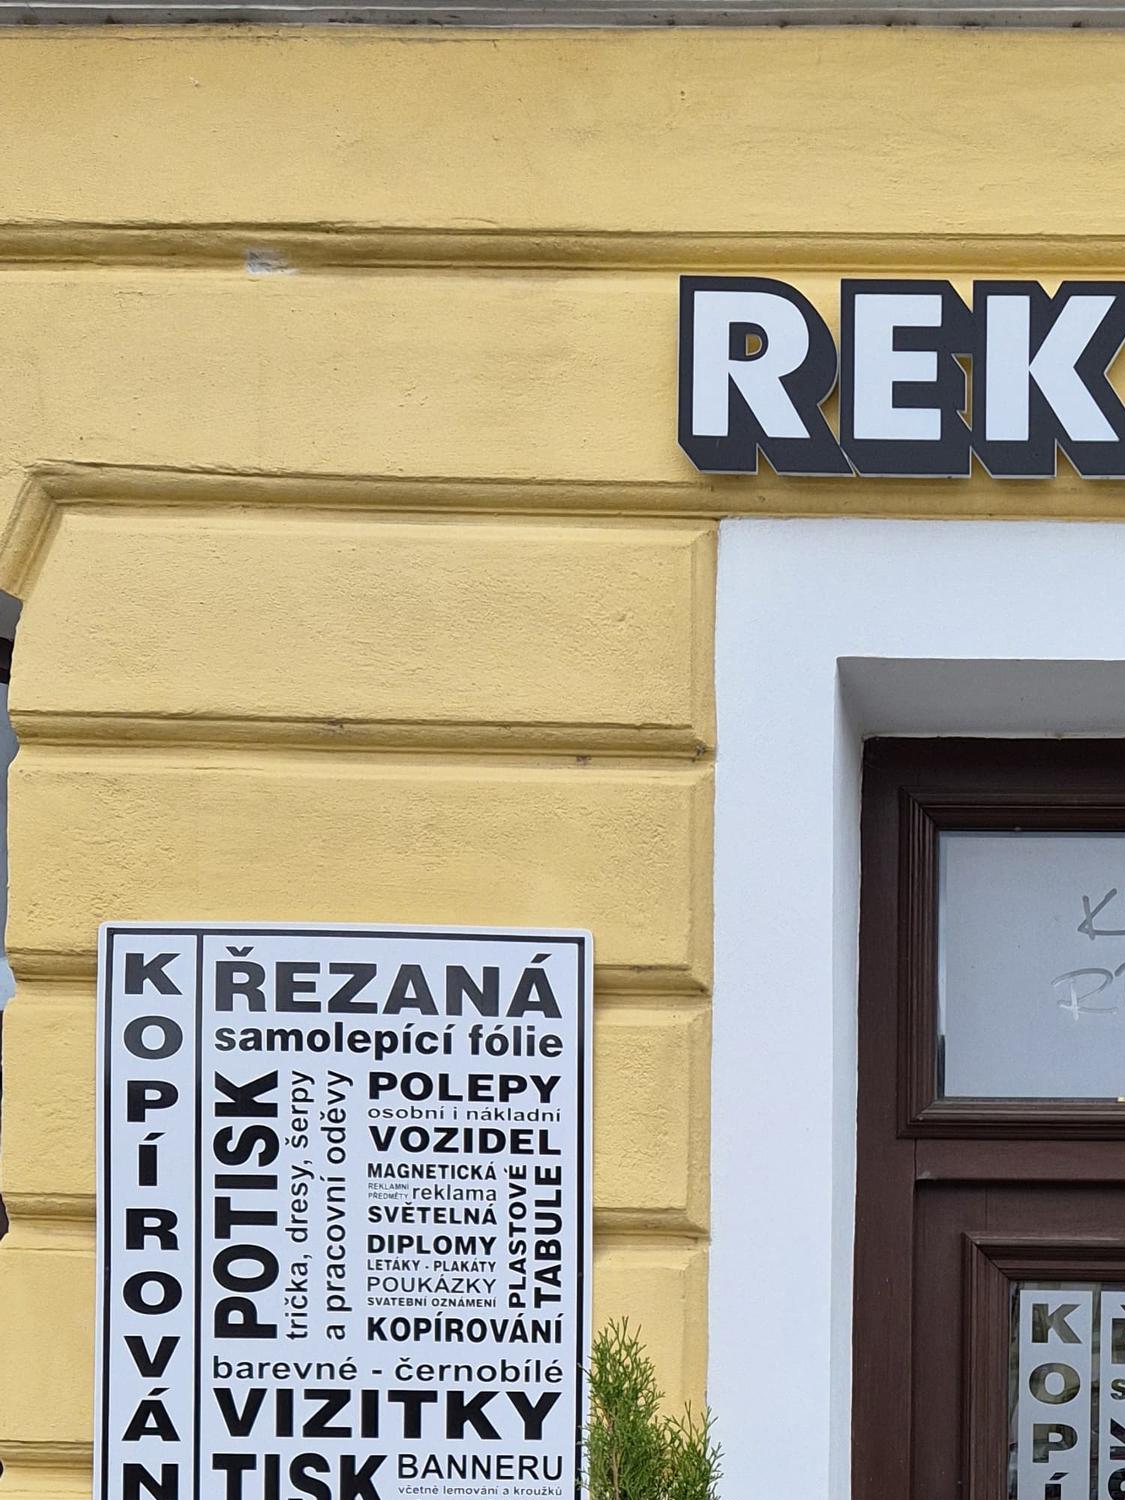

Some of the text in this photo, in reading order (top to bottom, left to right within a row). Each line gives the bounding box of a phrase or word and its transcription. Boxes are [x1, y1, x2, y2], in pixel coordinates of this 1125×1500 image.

[215, 946, 563, 1019] ŘEZANÁ
[214, 1022, 564, 1061] samolepící fólie
[368, 1071, 562, 1104] POLEPY
[368, 1106, 561, 1122] osobní i nákladní
[368, 1125, 562, 1156] VOZIDEL
[367, 1161, 497, 1180] MAGNETICKÁ
[212, 1070, 280, 1339] POTISK
[285, 1070, 316, 1340] trička, dresy, šerpy
[320, 1070, 354, 1341] a pracovní oděvy
[412, 1184, 497, 1202] reklama
[367, 1202, 498, 1225] SVĚTELNÁ
[367, 1234, 498, 1256] DIPLOMY
[504, 1164, 527, 1309] PLASTOVÉ
[533, 1165, 563, 1309] TABULE
[367, 1257, 421, 1271] LETÁKY
[433, 1258, 497, 1273] PLAKÁTY
[367, 1274, 497, 1294] POUKÁZKY
[367, 1296, 497, 1308] SVATEBNÍ OZNÁMENÍ
[367, 1311, 565, 1344] KOPÍROVÁNÍ
[212, 1356, 358, 1381] barevné
[394, 1357, 564, 1383] černobílé
[212, 1387, 563, 1441] VIZITKY
[397, 1453, 563, 1481] BANNERU
[397, 1484, 563, 1497] včetně lemování a kroužků
